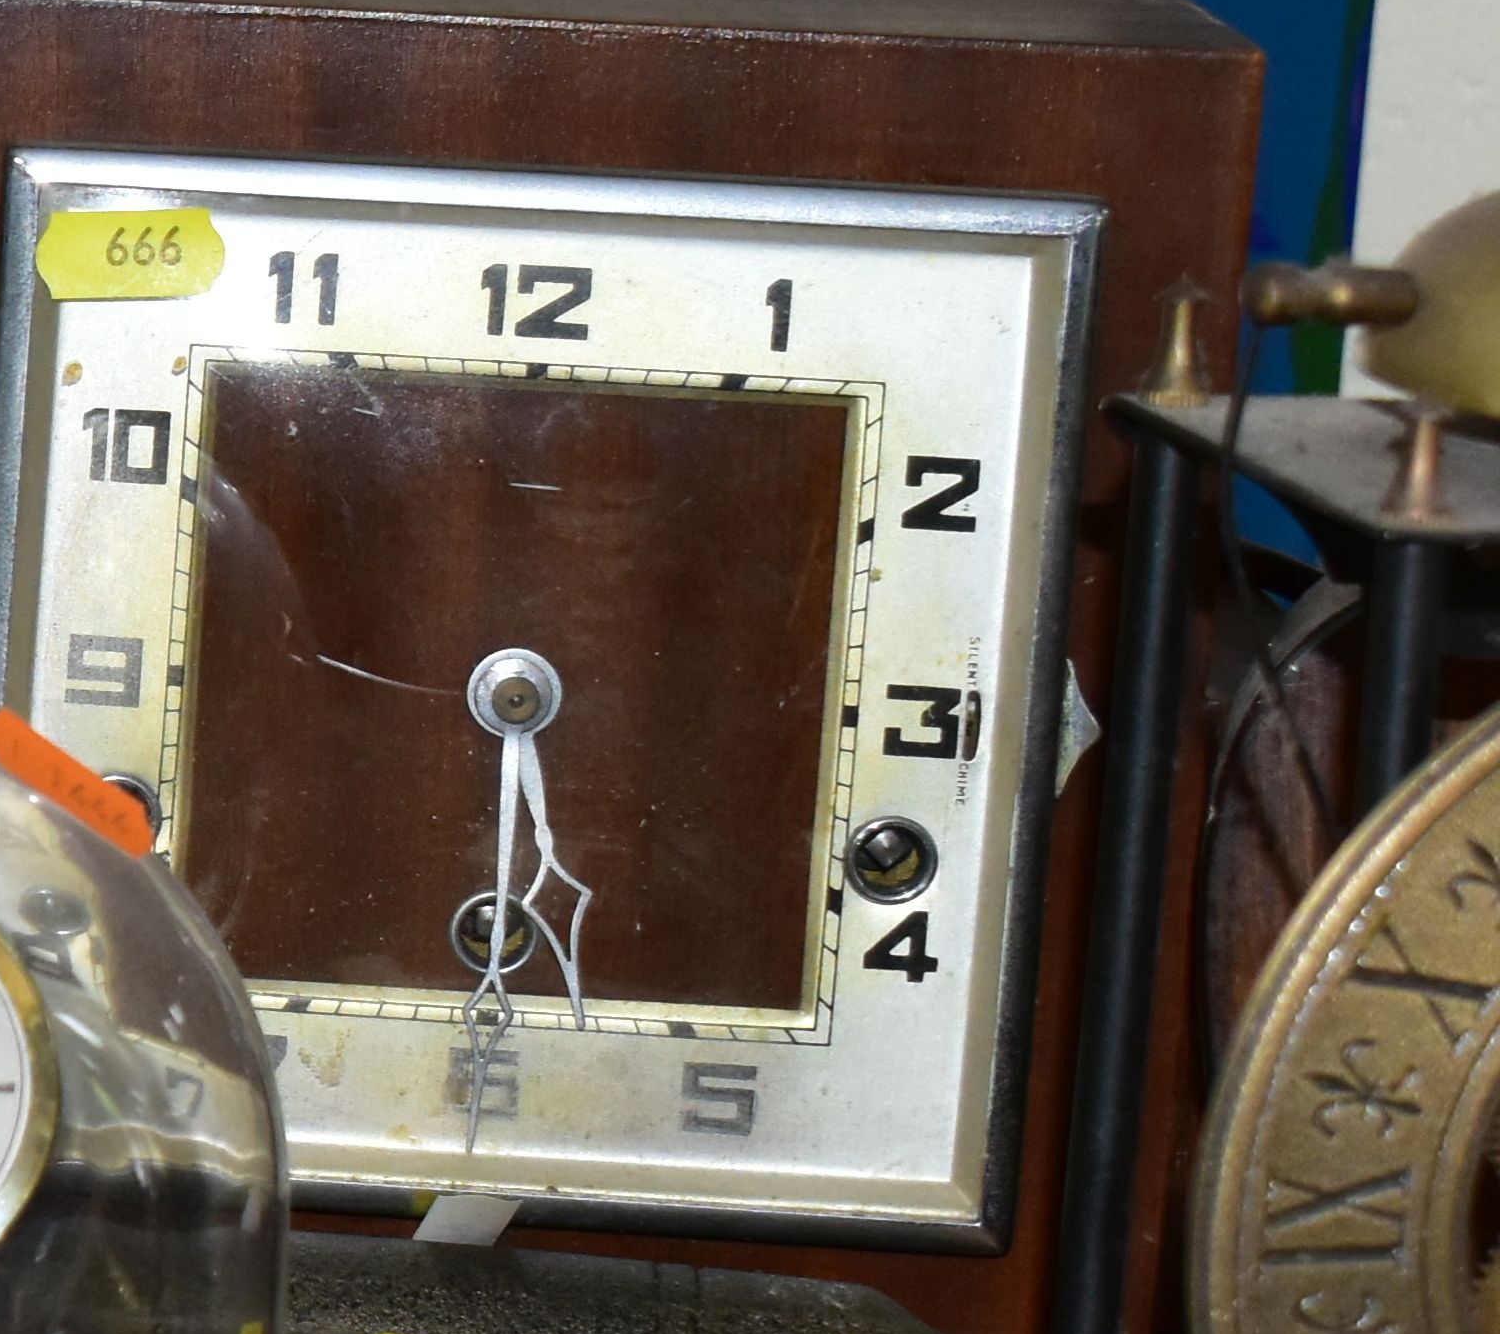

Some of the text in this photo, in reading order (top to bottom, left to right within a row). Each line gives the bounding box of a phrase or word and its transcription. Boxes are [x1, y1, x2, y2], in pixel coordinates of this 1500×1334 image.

[105, 225, 182, 266] 666
[268, 250, 340, 325] 11
[480, 263, 593, 341] 12
[765, 278, 793, 352] 1
[82, 407, 172, 485] 10
[901, 455, 981, 533] 2
[63, 633, 144, 708] 9
[966, 636, 981, 687] SILENT
[883, 683, 962, 759] 3
[955, 762, 970, 806] CHIME
[862, 910, 939, 983] 4
[444, 1046, 520, 1119] 6
[681, 1061, 758, 1137] 5
